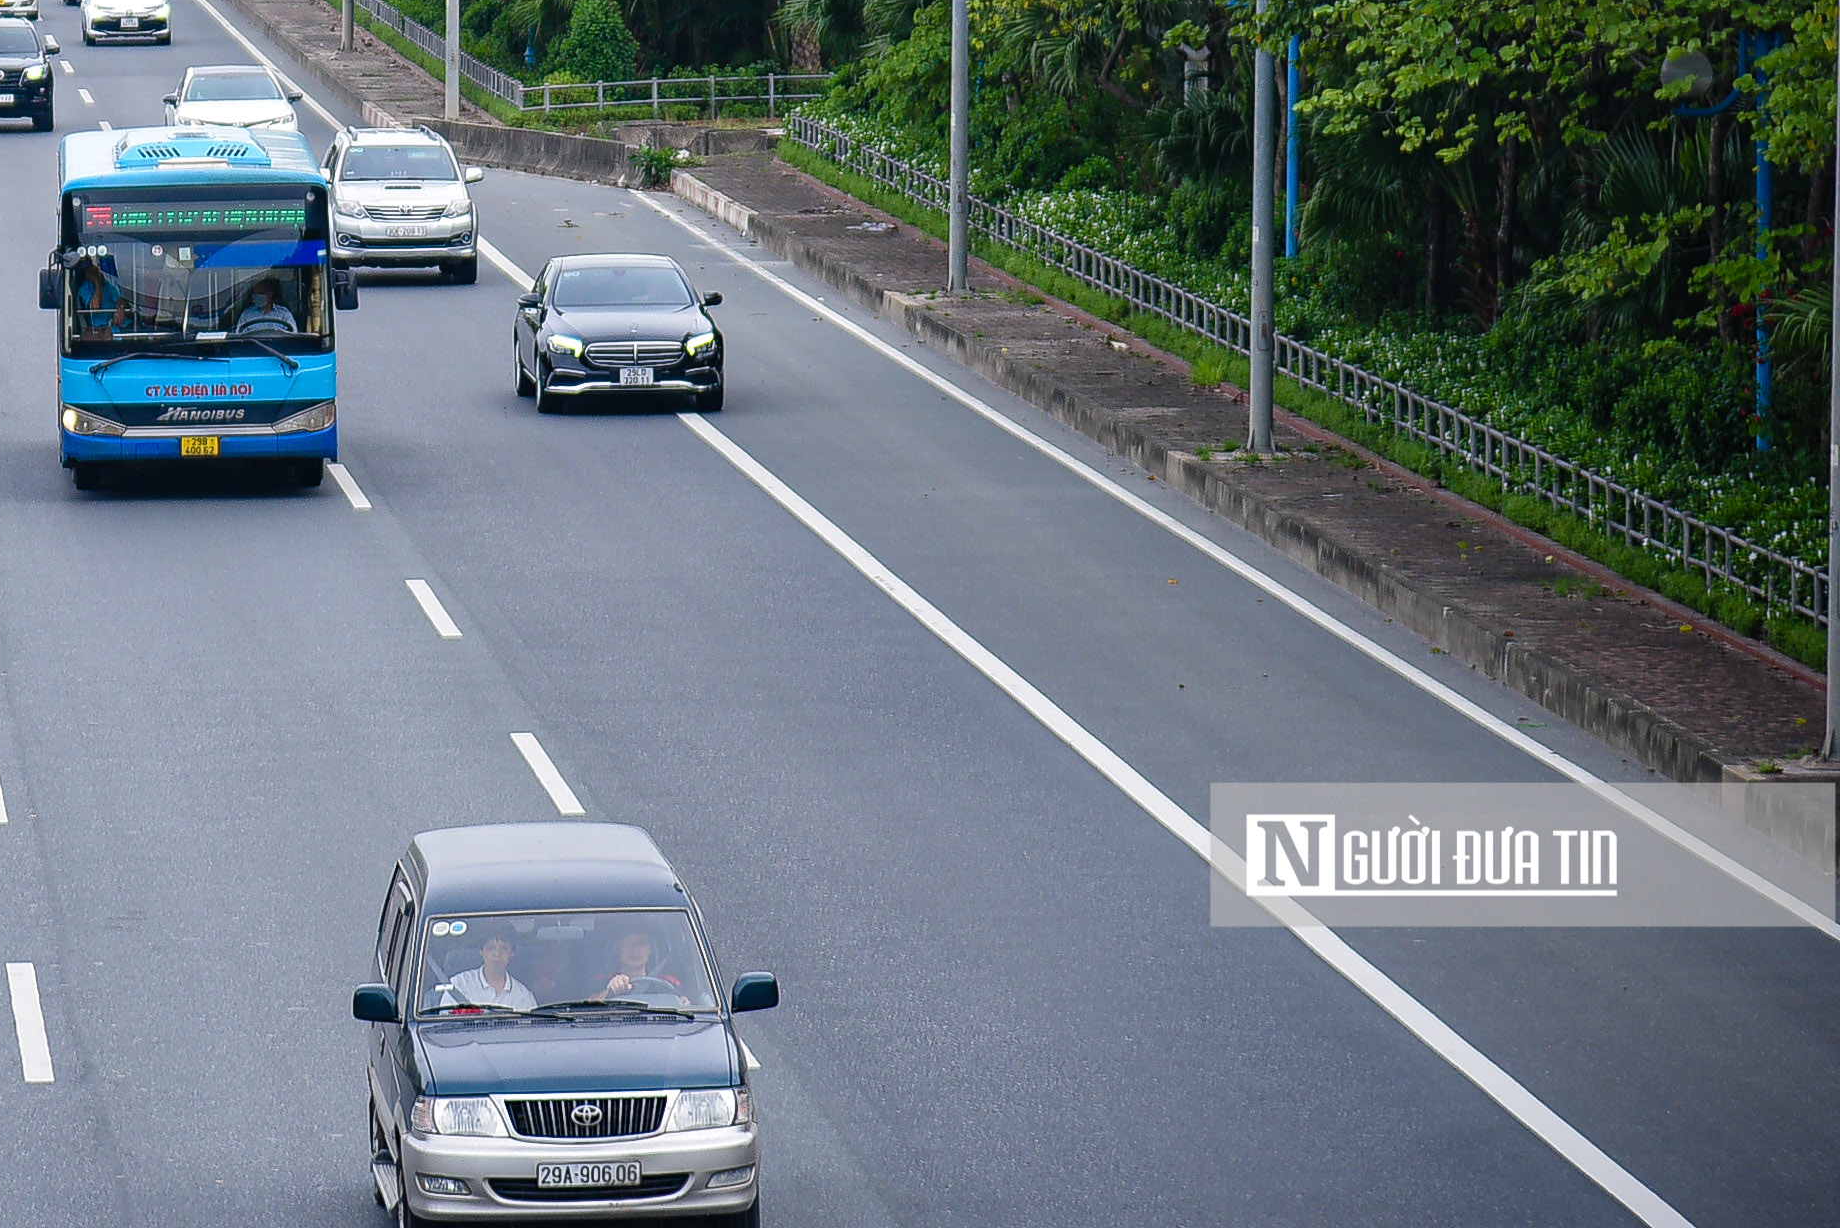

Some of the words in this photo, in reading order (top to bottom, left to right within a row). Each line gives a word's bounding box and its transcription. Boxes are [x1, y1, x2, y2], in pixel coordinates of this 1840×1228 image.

[145, 385, 161, 397] CT
[163, 385, 178, 396] XE
[181, 383, 209, 399] ĐIỆN
[212, 382, 227, 396] HÀ
[230, 380, 252, 399] NỘI
[156, 406, 245, 421] HANOIBUS
[191, 437, 208, 446] 29B
[541, 1164, 638, 1184] 29A-906.06
